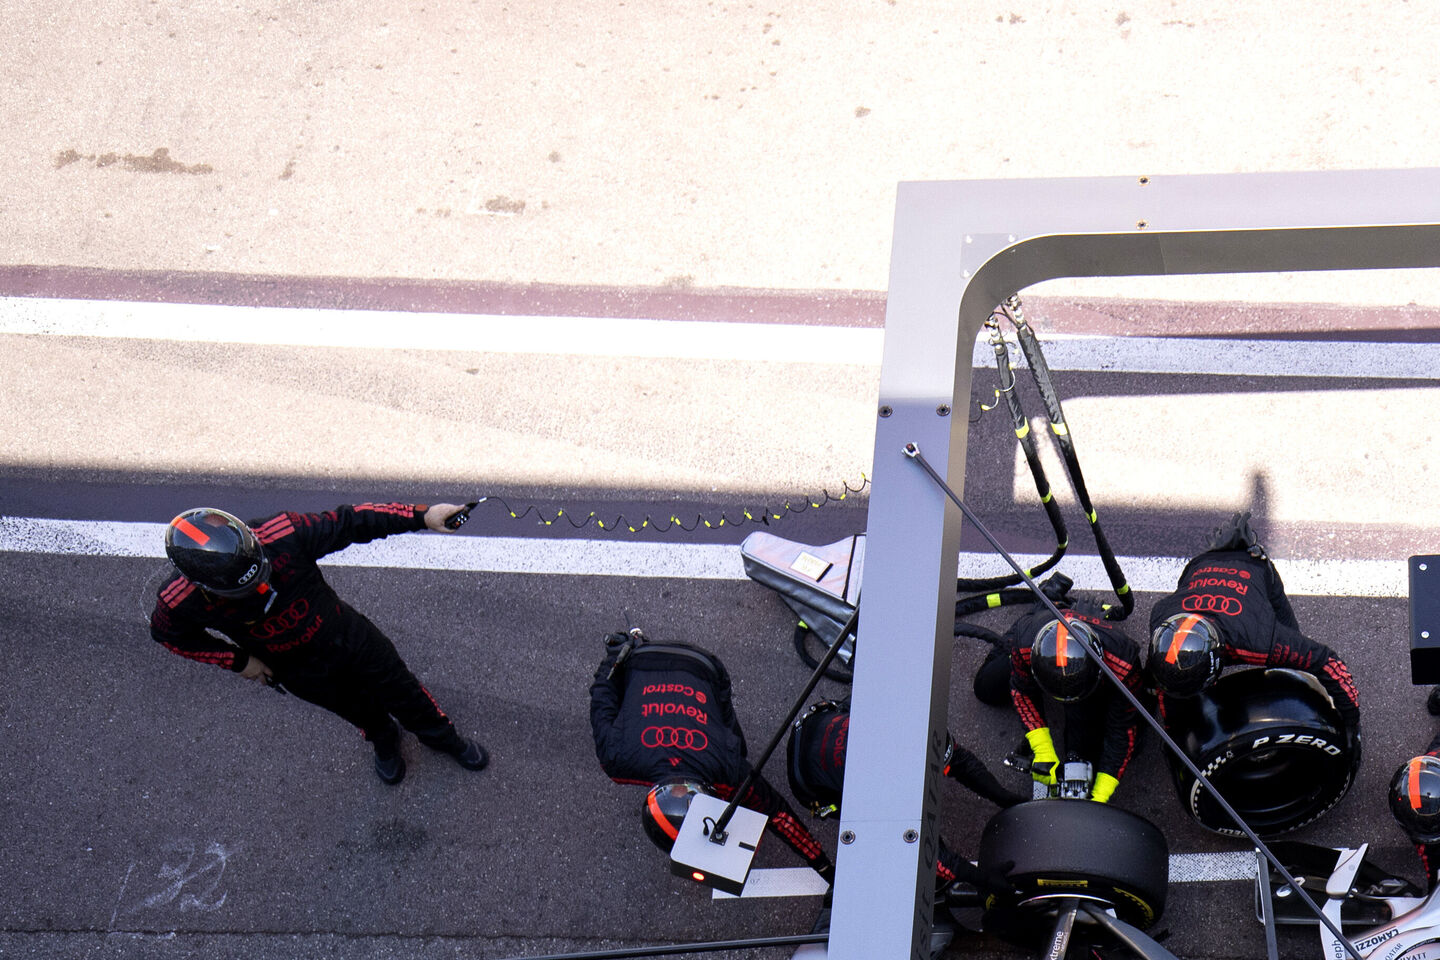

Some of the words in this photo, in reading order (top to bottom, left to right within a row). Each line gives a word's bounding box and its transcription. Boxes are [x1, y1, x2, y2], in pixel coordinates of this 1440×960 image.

[1189, 579, 1248, 596] Revolut
[642, 682, 695, 697] Castrol
[641, 703, 708, 725] Revolut
[1252, 736, 1270, 749] P
[1275, 733, 1342, 756] ZERO
[1355, 928, 1400, 953] CAMOZZI
